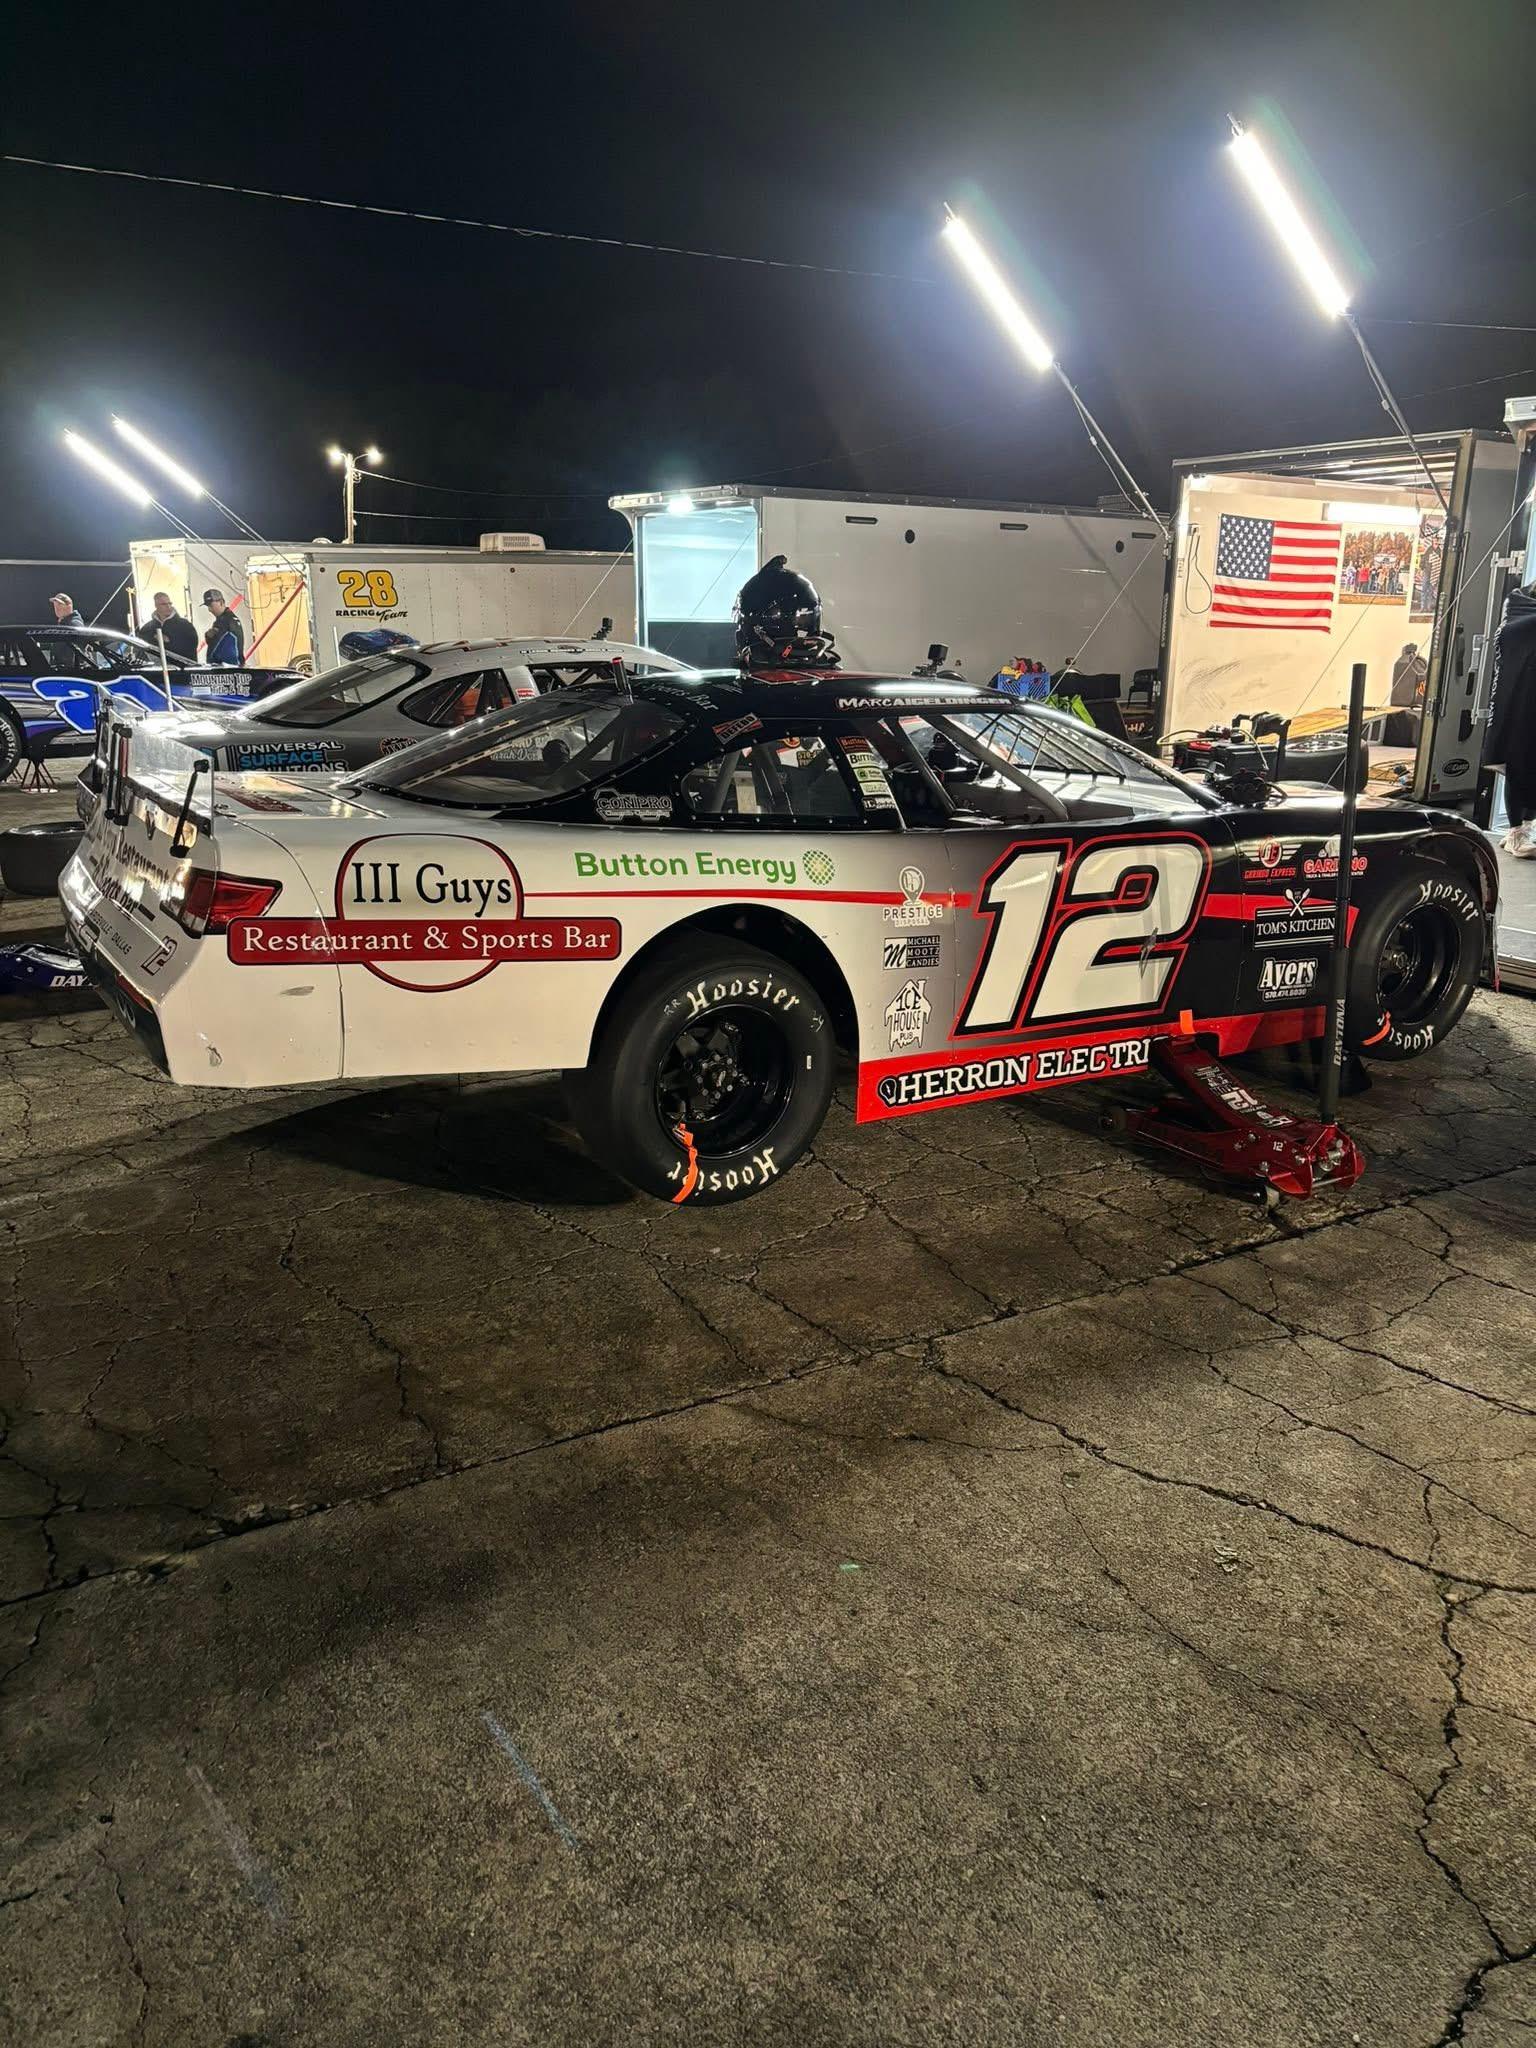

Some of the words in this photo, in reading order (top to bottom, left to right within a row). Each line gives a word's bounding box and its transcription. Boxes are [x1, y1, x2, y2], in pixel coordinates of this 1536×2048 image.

[337, 570, 398, 607] 28
[336, 609, 375, 617] RACING
[376, 609, 408, 623] Team
[1487, 701, 1496, 728] NEW
[238, 741, 342, 754] UNIVERSAL
[239, 751, 324, 768] SURFACE
[574, 852, 688, 877] Button
[695, 852, 797, 885] Energy
[351, 862, 402, 903] III
[415, 863, 512, 918] Guys
[1415, 880, 1480, 921] Hoosier
[883, 905, 942, 919] PRESTIGE
[953, 836, 1208, 1033] 12
[1256, 921, 1287, 935] TOM'S
[1289, 918, 1335, 933] KITCHEN
[243, 926, 417, 952] Restaurant
[423, 926, 449, 950] &
[461, 926, 553, 957] Sports
[564, 926, 611, 949] Bar
[907, 936, 940, 946] MICHAEL
[907, 947, 940, 956] MOOTZ
[906, 957, 939, 967] CANDIES
[1260, 960, 1317, 990] Ayers
[684, 973, 800, 1019] Hoosier
[895, 986, 922, 1012] ICE
[893, 1010, 921, 1033] HOUSE
[1333, 999, 1346, 1067] DAYTONA
[899, 1031, 913, 1040] PUB
[897, 1055, 1031, 1104] HERRON
[1036, 1037, 1160, 1080] ELECTRI
[1272, 1142, 1284, 1152] 12
[667, 1147, 781, 1197] Hoosir
